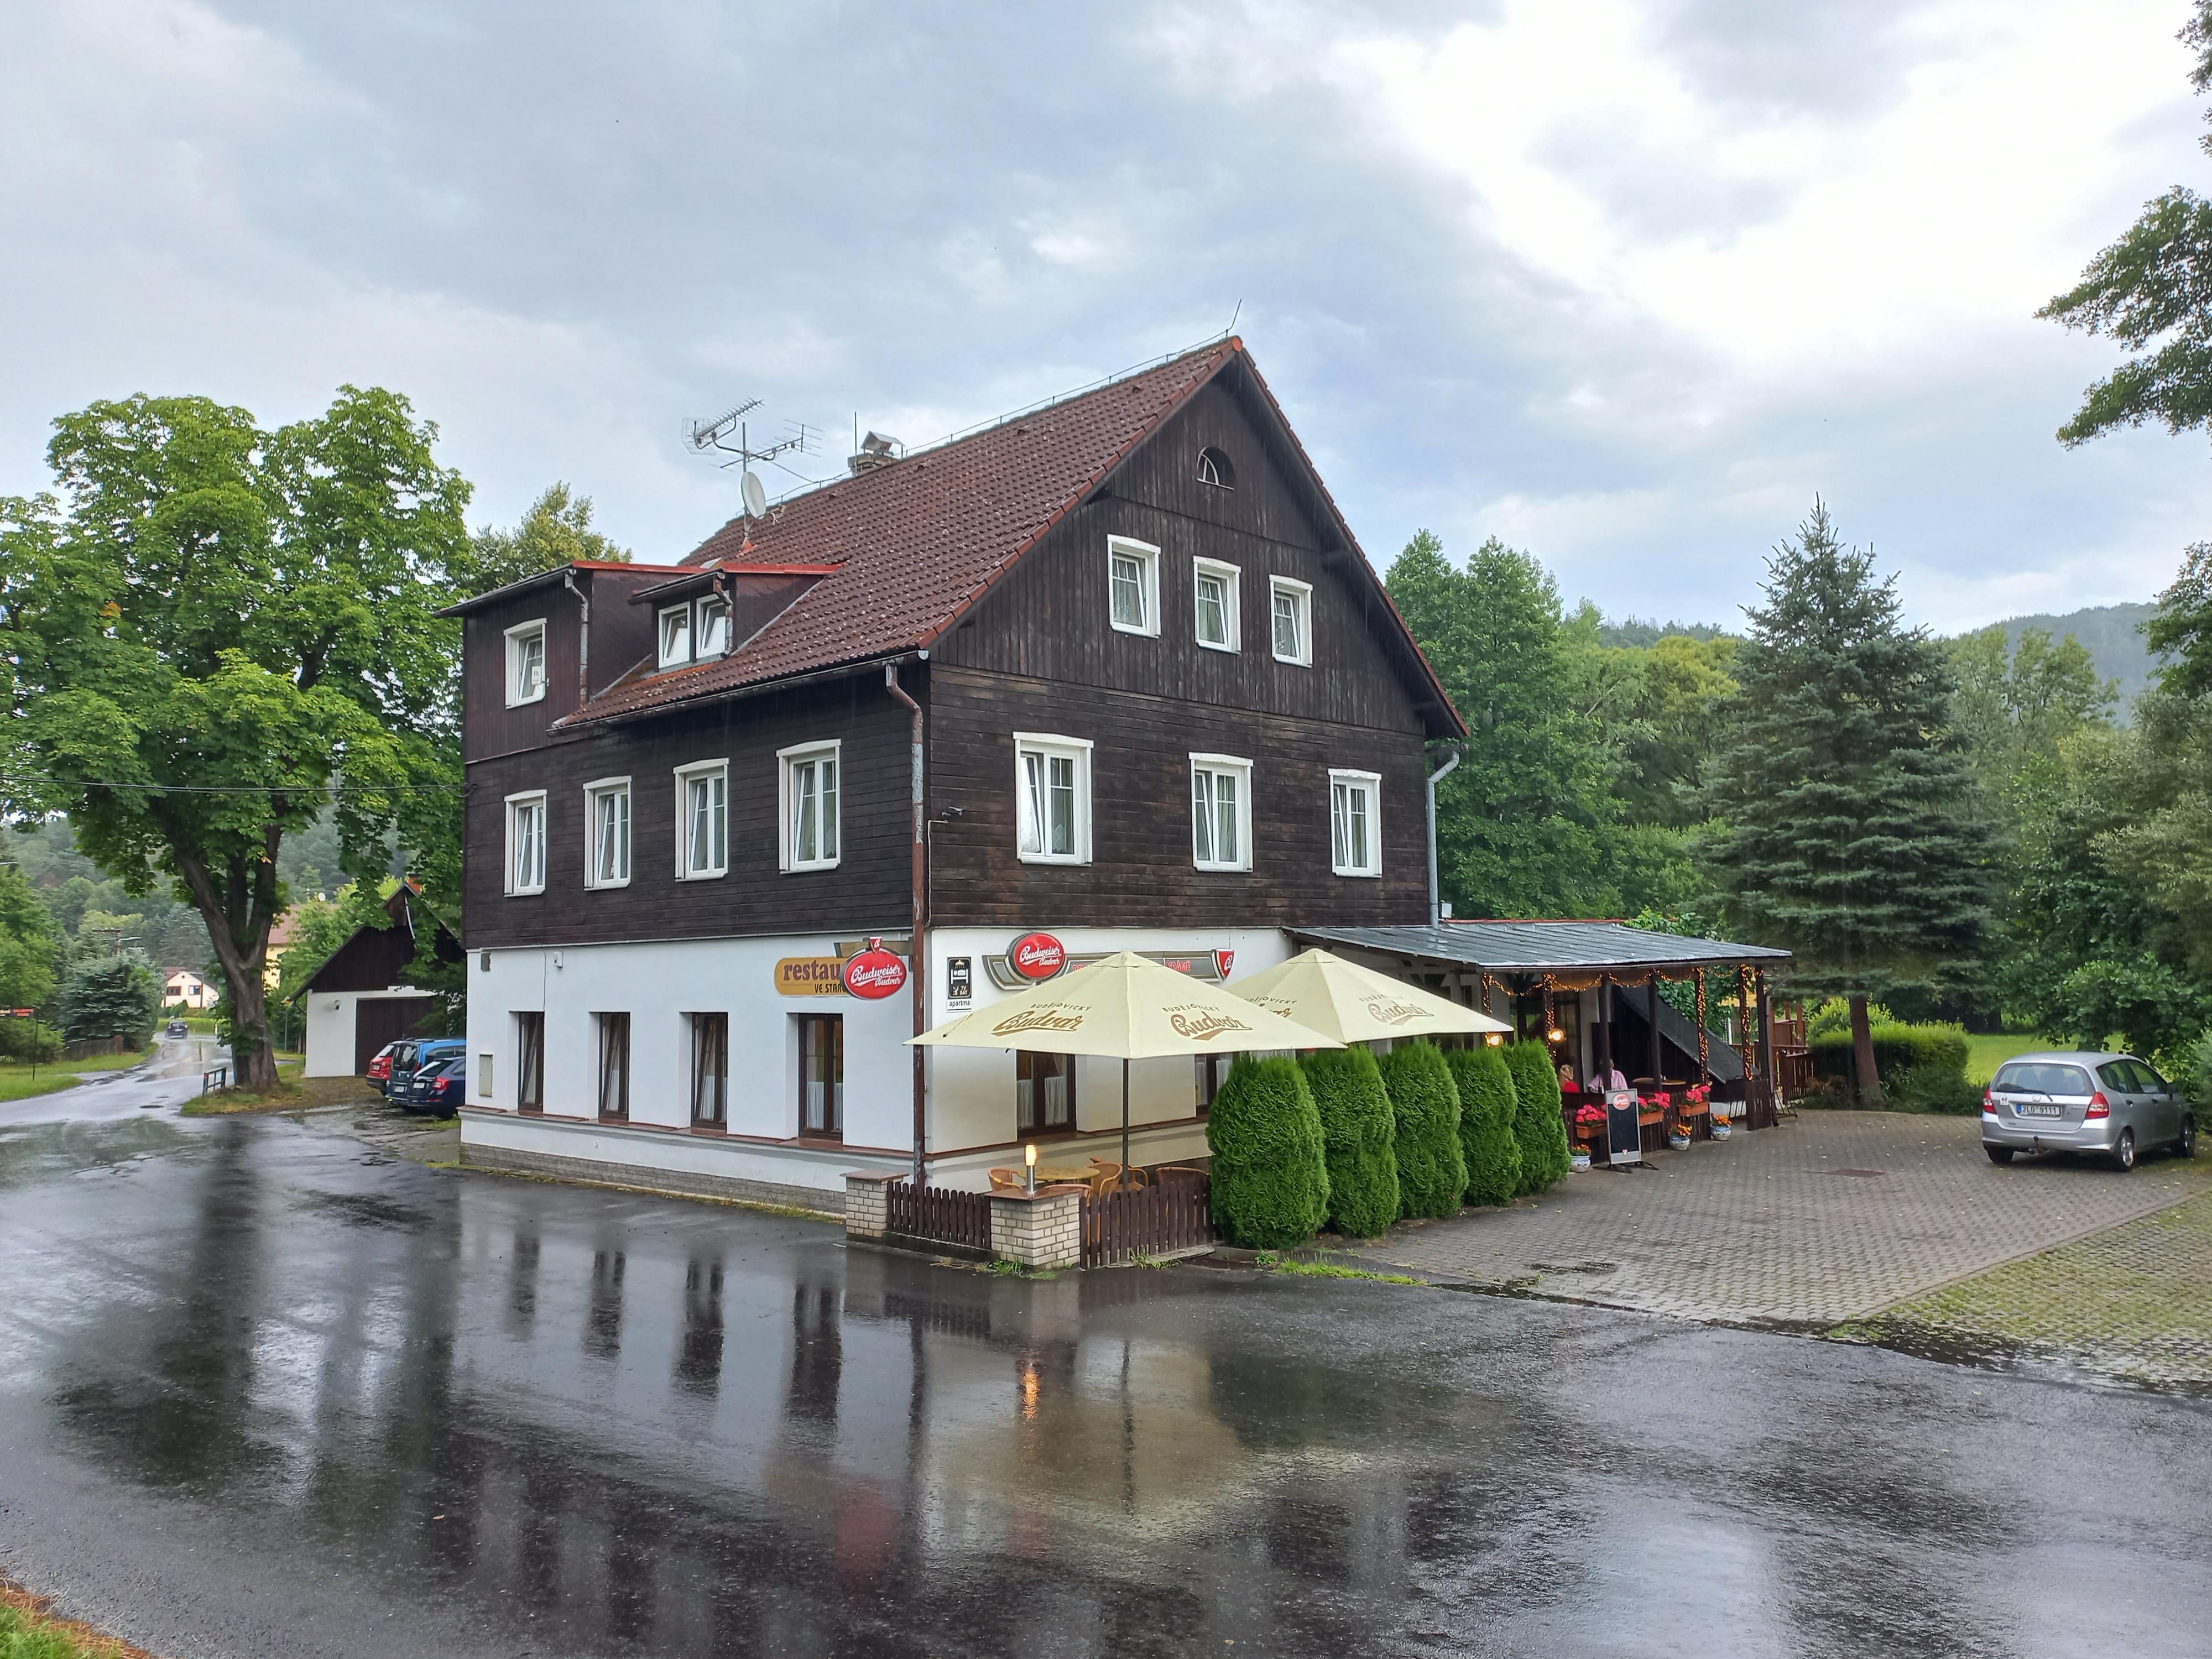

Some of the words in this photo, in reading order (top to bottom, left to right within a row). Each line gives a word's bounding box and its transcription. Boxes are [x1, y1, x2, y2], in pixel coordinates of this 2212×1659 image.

[1019, 945, 1062, 966] Budweiser
[1039, 957, 1060, 967] Budvar
[850, 964, 902, 987] Budweiser
[874, 977, 901, 987] Budvar
[814, 983, 823, 993] VE
[990, 1010, 1084, 1036] Budvar
[1368, 1000, 1435, 1025] Budvar
[1170, 1011, 1253, 1040] Budvar
